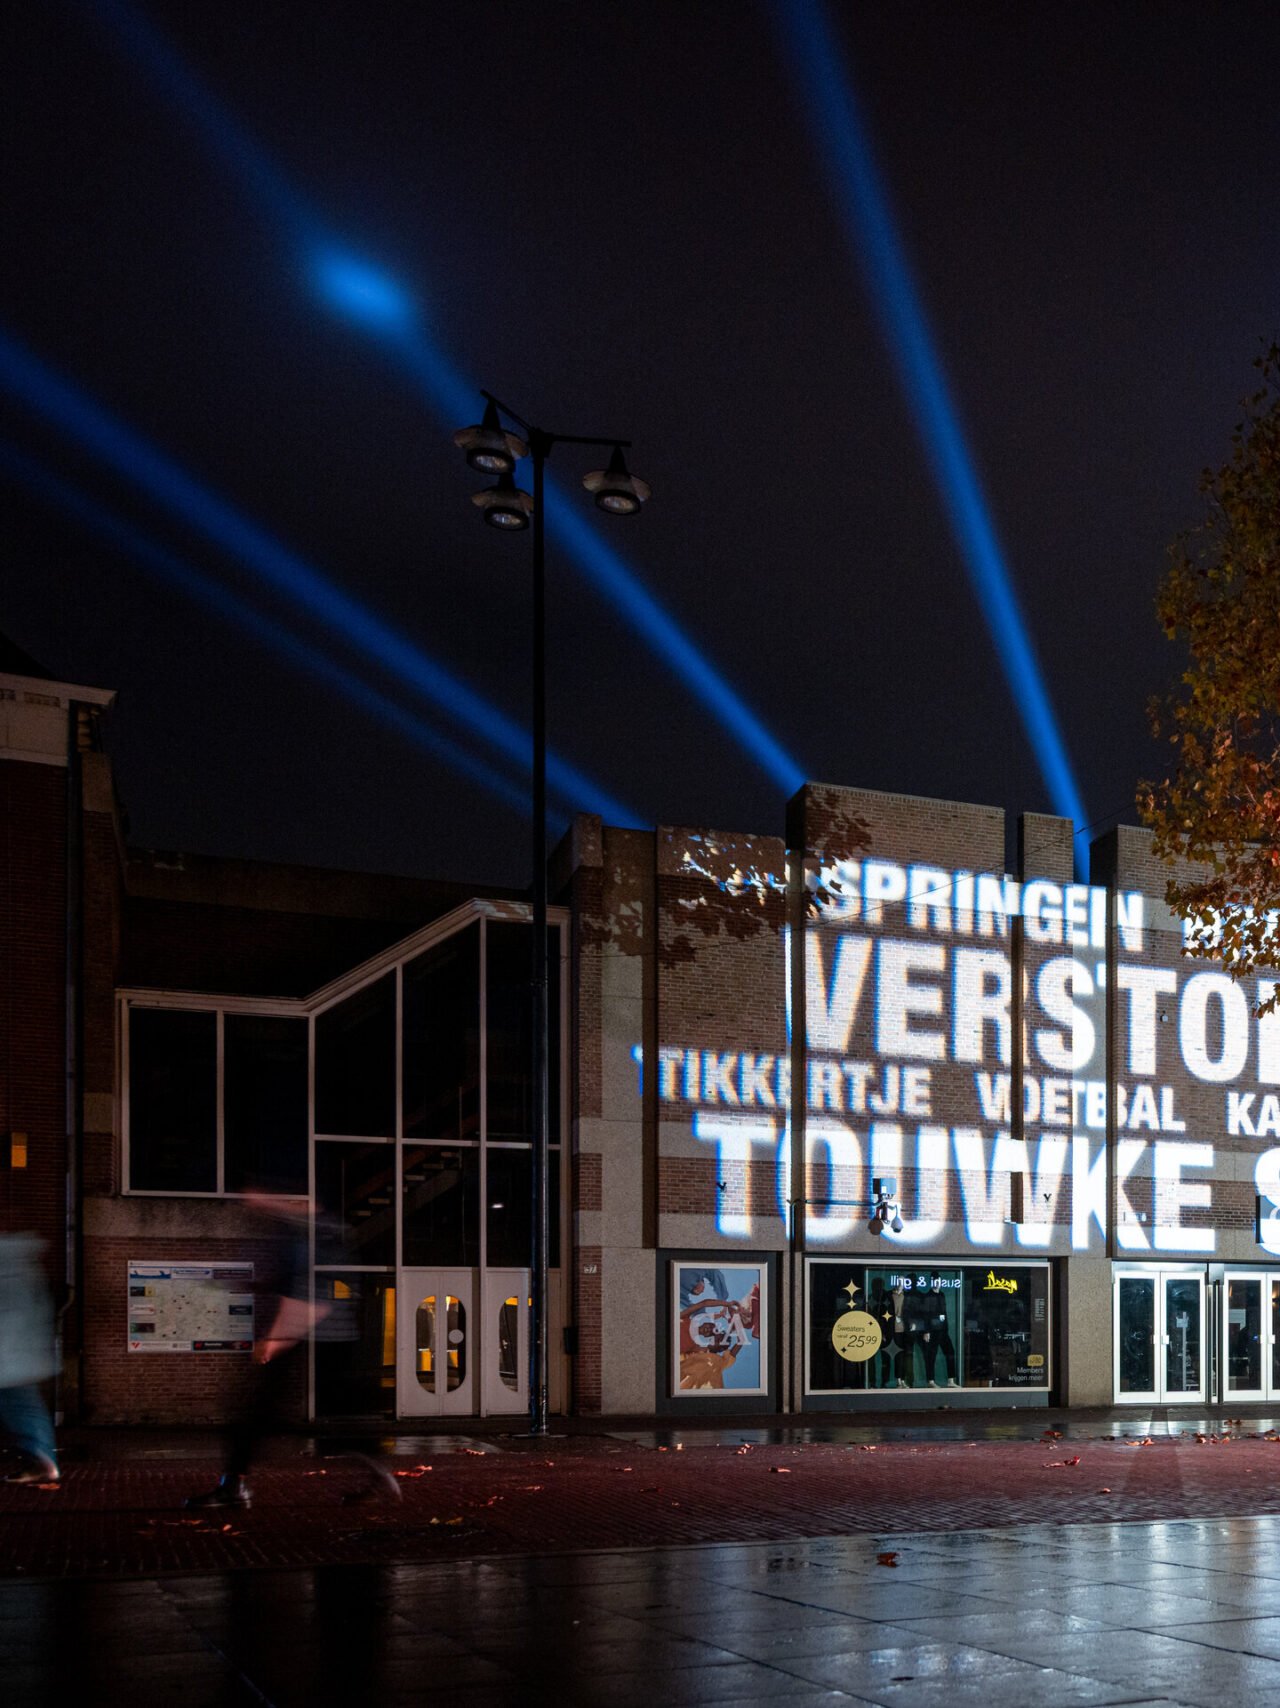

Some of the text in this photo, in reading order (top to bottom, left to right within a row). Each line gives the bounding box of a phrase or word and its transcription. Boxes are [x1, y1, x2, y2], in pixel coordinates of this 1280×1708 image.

[974, 1072, 1186, 1132] VOETBAL
[694, 1111, 1216, 1252] TOUWKE
[689, 1312, 752, 1347] C&A
[837, 1324, 866, 1333] Sweaters
